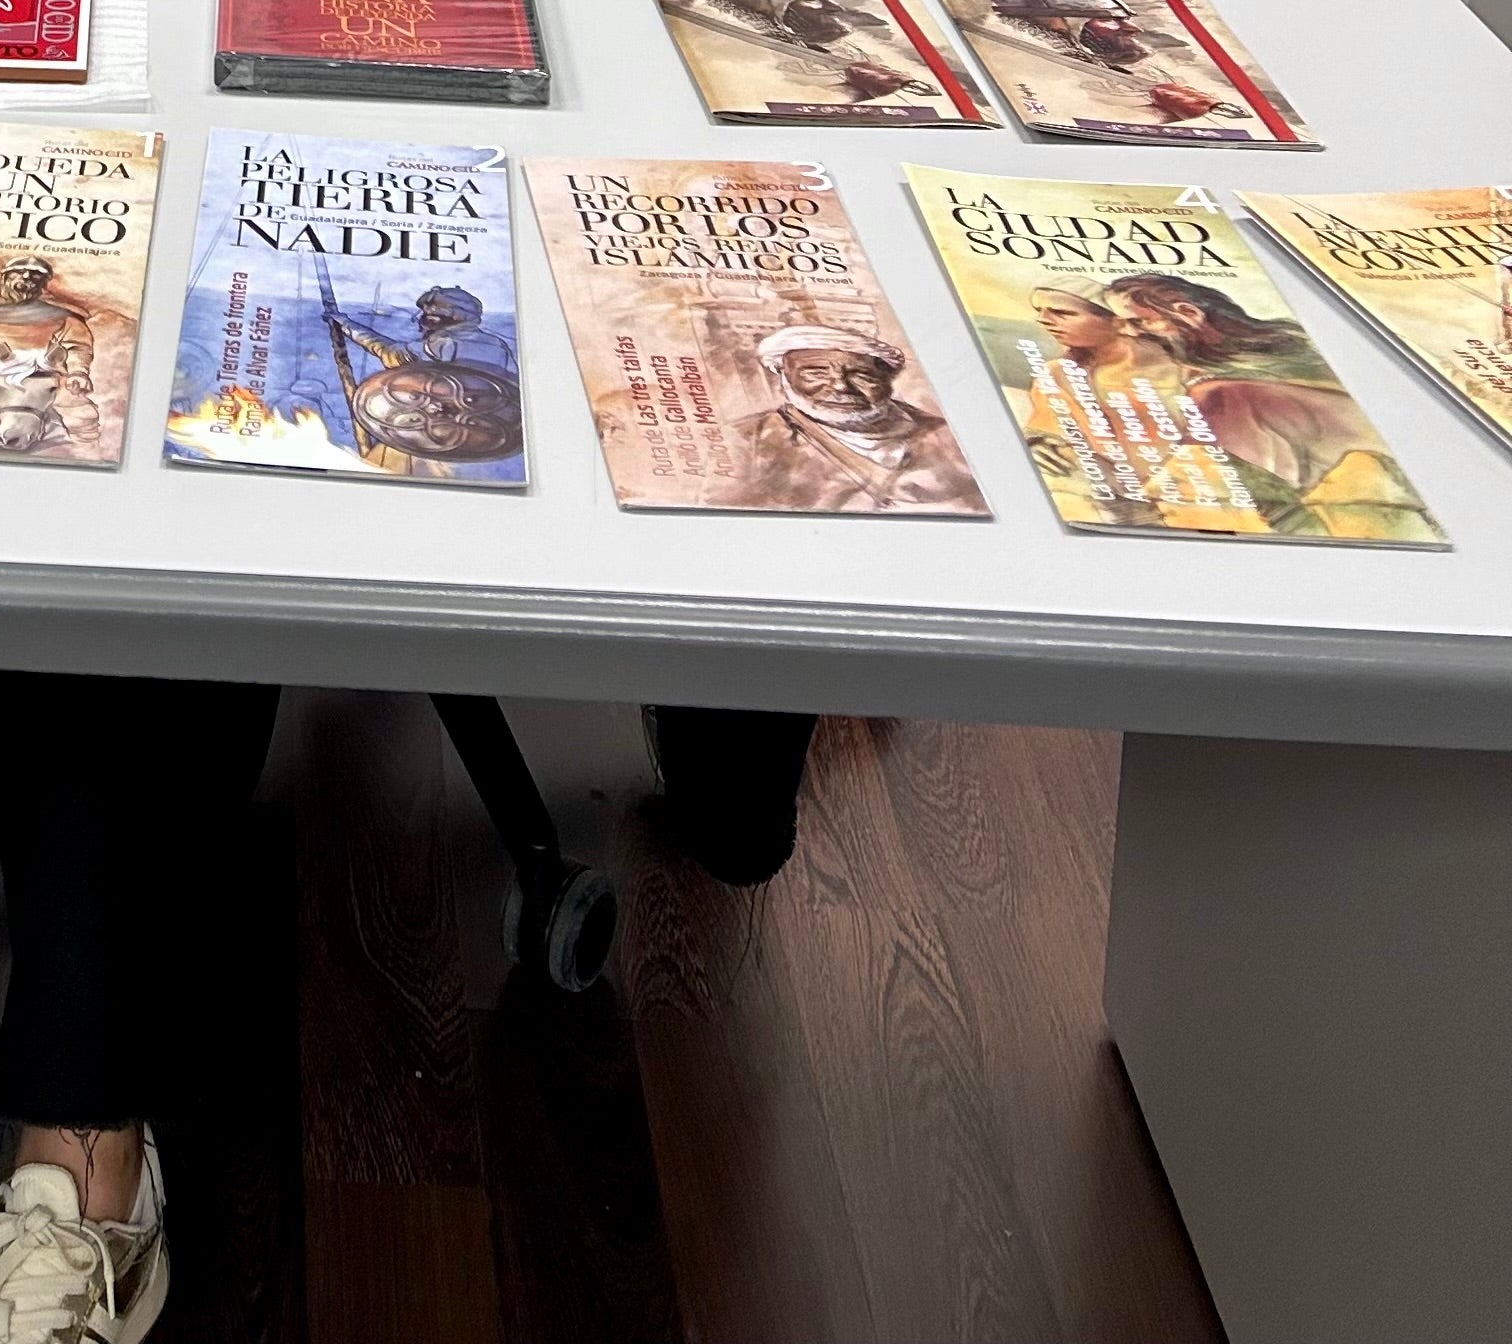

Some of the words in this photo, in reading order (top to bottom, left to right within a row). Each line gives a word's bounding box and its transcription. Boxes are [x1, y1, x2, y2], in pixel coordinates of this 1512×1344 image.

[340, 15, 416, 38] UN
[319, 33, 442, 50] CAMINO
[242, 145, 294, 164] LA
[472, 144, 507, 173] 2
[241, 161, 486, 195] PELIGROSA
[563, 174, 631, 193] UN
[791, 161, 834, 192] 3
[239, 202, 287, 221] DE
[240, 178, 488, 220] TIERRA
[569, 192, 820, 216] RECORRIDO
[943, 186, 1008, 211] LA
[1173, 184, 1221, 215] 4
[290, 213, 368, 226] Guadalajara
[380, 217, 414, 229] Soria
[425, 221, 488, 234] Zaragoza
[576, 210, 692, 235] POR
[698, 214, 811, 240] LOS
[951, 206, 1212, 244] CIUDAD
[1291, 211, 1363, 231] LA
[42, 244, 121, 258] Guadalajara
[229, 217, 473, 264] NADIE
[584, 234, 701, 251] VIEJOS
[713, 237, 840, 256] REINOS
[1041, 262, 1087, 273] Teruel
[224, 271, 249, 321] frontera
[222, 321, 243, 338] de
[248, 306, 273, 343] Fáñez
[216, 338, 241, 382] Tierras
[245, 345, 269, 379] Alvar
[616, 335, 642, 373] taifas
[1015, 338, 1061, 395] Valencia
[1452, 348, 1489, 371] Sur
[248, 380, 266, 396] de
[630, 375, 651, 401] tres
[650, 355, 687, 424] Gallocanta
[676, 355, 718, 425] Montalbán
[1059, 358, 1116, 439] Maestrazgo
[210, 402, 237, 434] Ruta
[637, 403, 659, 426] Las
[1048, 397, 1073, 414] de
[1106, 391, 1153, 444] Morella
[1173, 394, 1218, 443] Olocau
[646, 428, 665, 445] de
[673, 425, 694, 441] de
[701, 426, 724, 442] de
[650, 447, 677, 478] Ruta
[677, 443, 707, 478] Anillo
[709, 444, 739, 479] Anillo
[1057, 415, 1106, 482] conquista
[1095, 440, 1129, 462] del
[1136, 444, 1163, 464] de
[1203, 444, 1229, 464] de
[1091, 482, 1117, 502] La
[1113, 463, 1152, 504] Anillo
[1148, 465, 1189, 506] Anillo
[1218, 465, 1259, 510] Ramal
